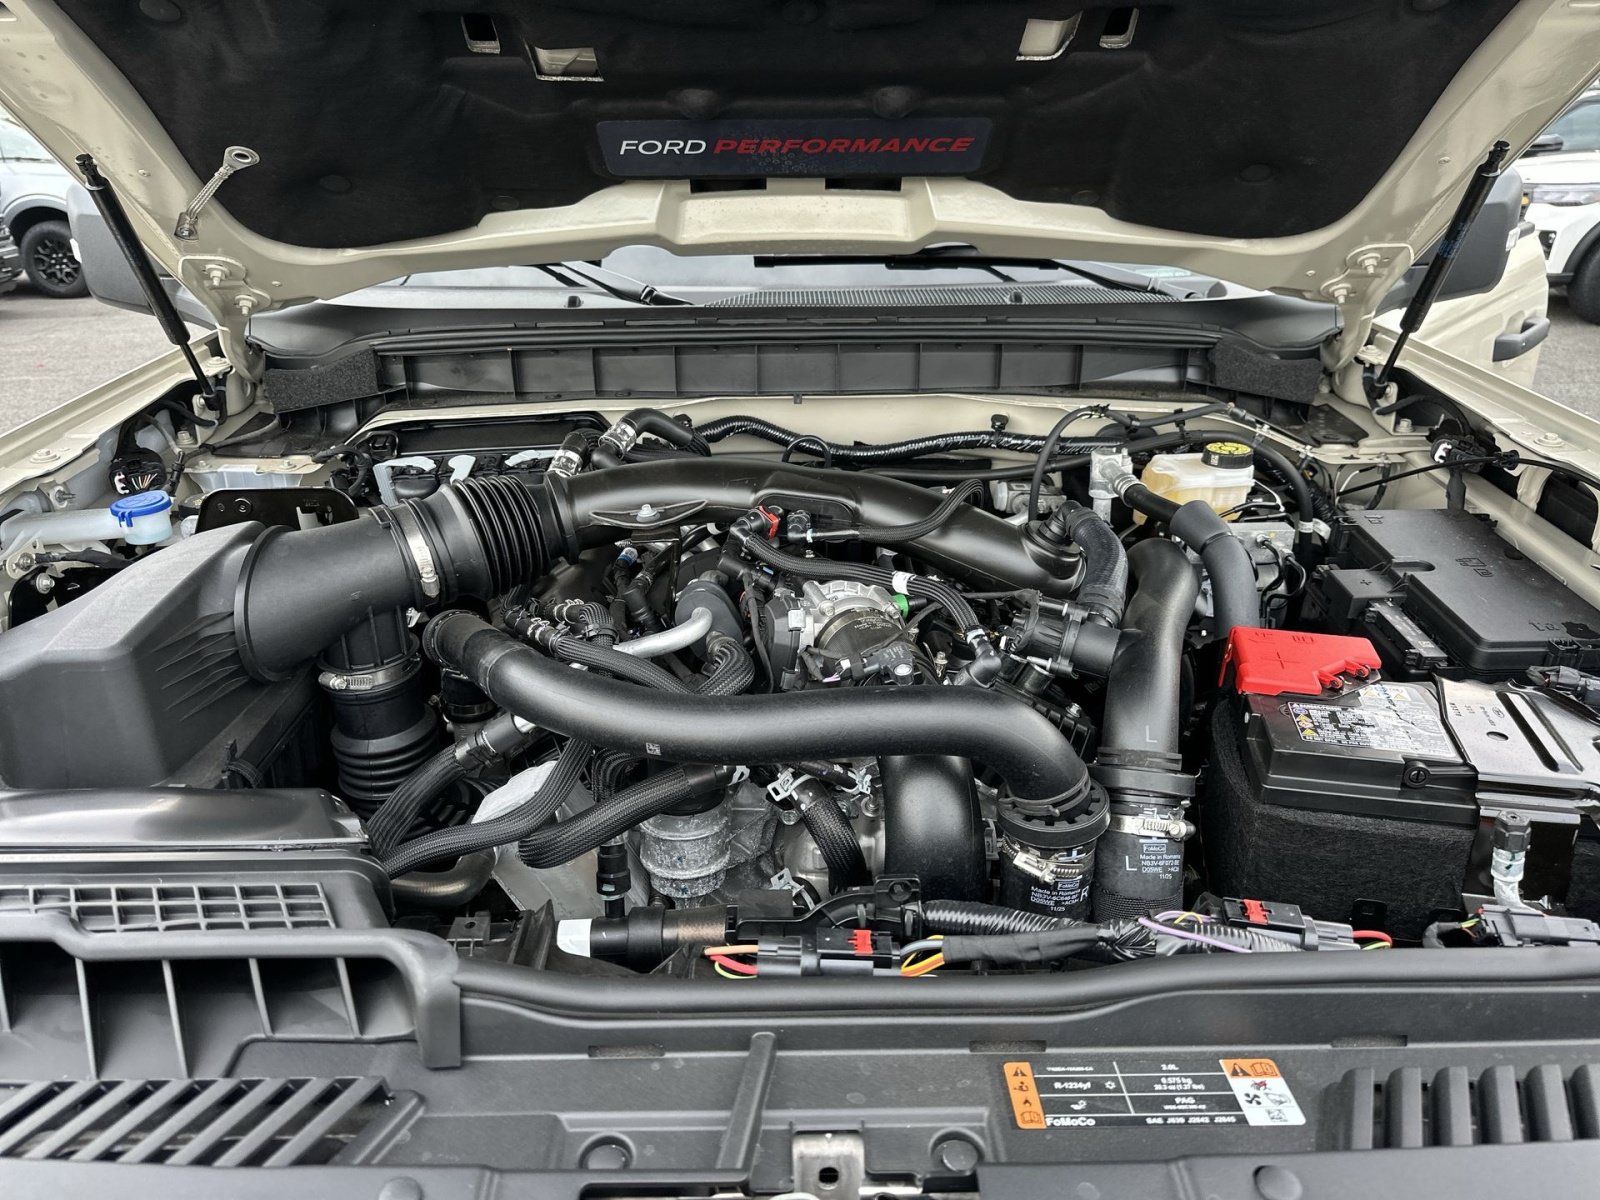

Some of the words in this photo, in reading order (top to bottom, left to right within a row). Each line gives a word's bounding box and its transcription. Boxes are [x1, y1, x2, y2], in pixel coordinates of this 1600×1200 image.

[619, 140, 707, 155] FORD
[713, 137, 976, 155] PERFORMANCE
[1145, 724, 1158, 743] L
[1125, 855, 1138, 871] L
[1030, 886, 1051, 894] Made
[1080, 885, 1090, 902] R
[1045, 1116, 1096, 1127] FoMoCo
